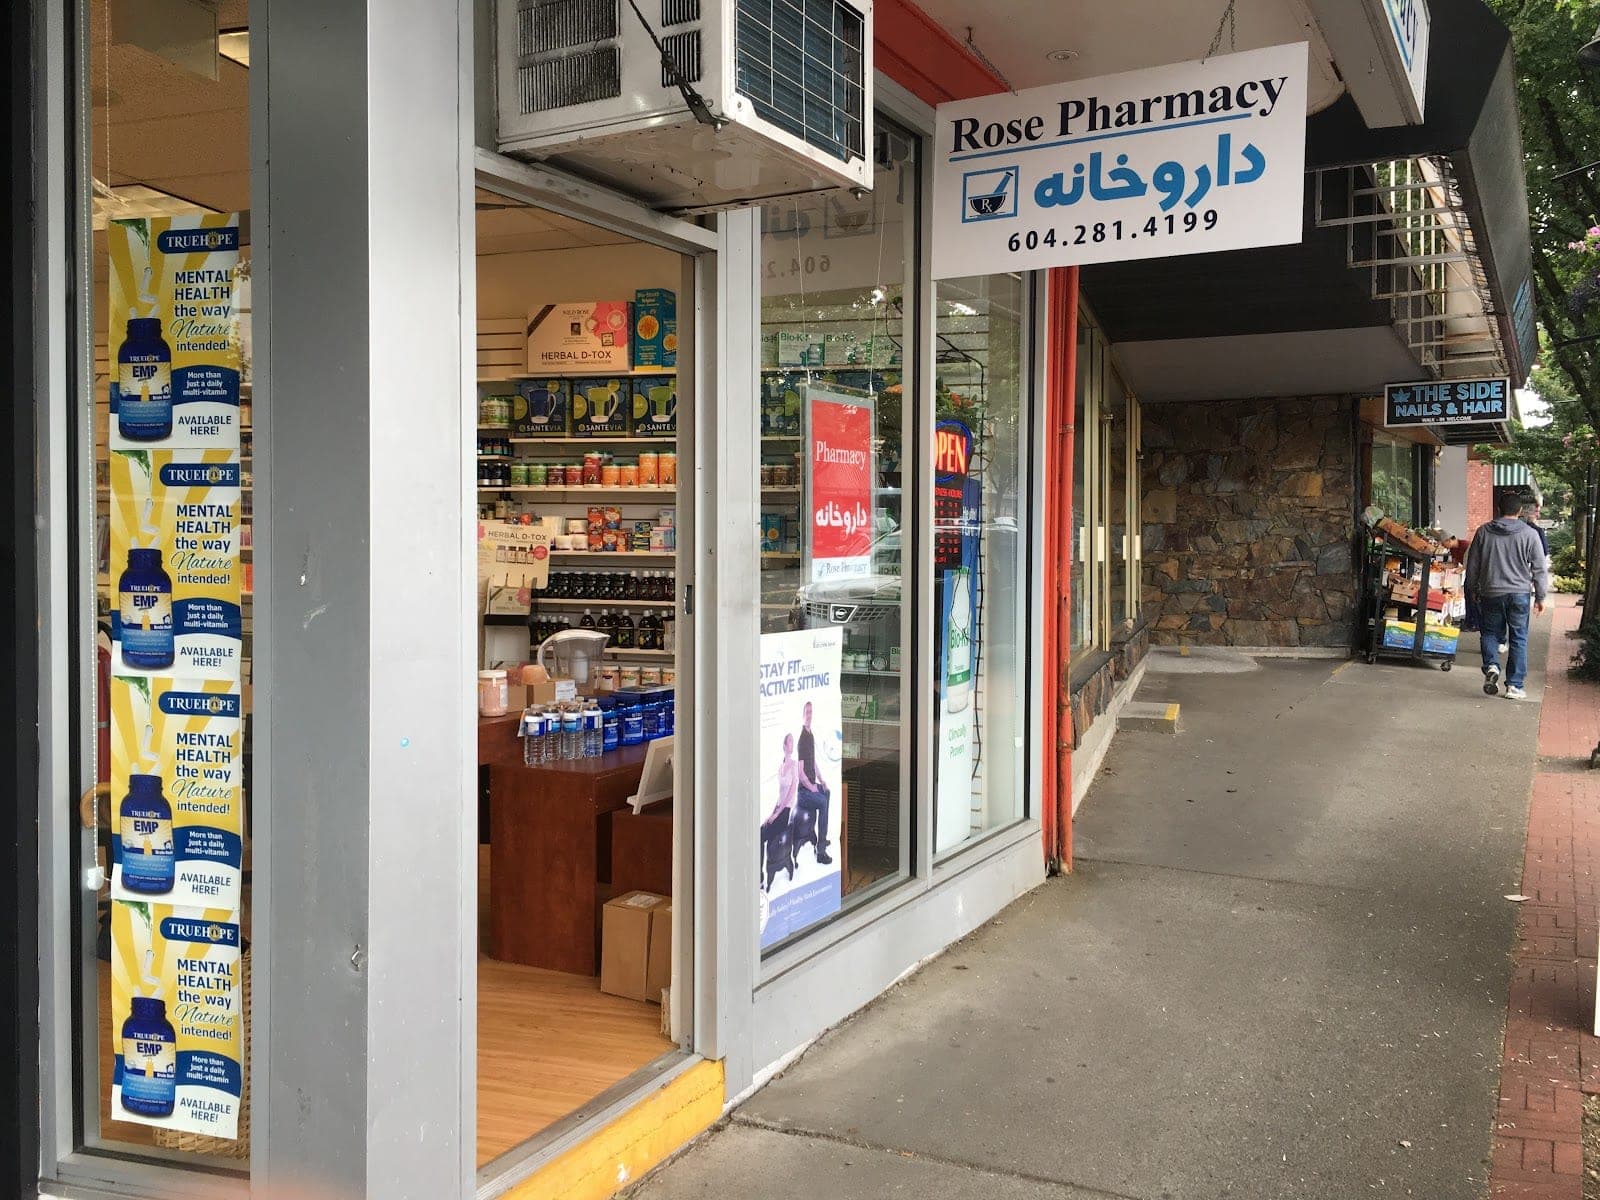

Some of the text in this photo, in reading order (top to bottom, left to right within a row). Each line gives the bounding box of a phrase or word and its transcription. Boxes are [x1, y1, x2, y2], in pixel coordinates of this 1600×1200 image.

[951, 76, 1289, 153] Rose Pharmacy
[1034, 133, 1266, 211] داروخانه
[1008, 209, 1218, 251] 604.281.4199
[166, 233, 232, 248] TRUEHOPE
[175, 270, 232, 284] MENTAL
[175, 287, 230, 300] HEALTH
[174, 304, 230, 319] the way
[170, 319, 232, 338] Nature
[177, 340, 230, 351] intended!
[542, 351, 611, 360] HERBAL D-TOX
[133, 365, 157, 377] EMP
[187, 380, 199, 388] just
[207, 380, 222, 388] daily
[1412, 382, 1503, 402] THE SIDE
[1396, 400, 1503, 417] NAILS & HAIR
[178, 415, 231, 425] AVAILABLE
[190, 426, 219, 435] HERE!
[816, 441, 866, 470] Pharmacy
[169, 469, 234, 482] TRUEHOPE
[177, 505, 232, 517] MENTAL
[816, 501, 867, 535] داروخانه
[176, 522, 230, 533] HEALTH
[522, 532, 546, 540] D-TOX
[175, 537, 230, 552] the way
[171, 552, 232, 570] Nature
[178, 573, 230, 584] intended!
[133, 595, 158, 607] EMP
[187, 612, 199, 620] just
[208, 612, 224, 621] daily
[180, 647, 233, 657] AVAILABLE
[193, 658, 221, 667] HERE!
[760, 662, 784, 678] STAY
[788, 659, 801, 674] FIT
[760, 672, 829, 697] ACTIVE SITTING
[168, 698, 234, 711] TRUEHOPE
[176, 733, 232, 747] MENTAL
[176, 749, 230, 763] HEALTH
[176, 765, 231, 783] the way
[171, 779, 232, 799] Nature
[177, 801, 229, 814] intended!
[134, 821, 159, 833] EMP
[189, 831, 206, 839] More
[189, 839, 200, 847] just
[208, 841, 224, 849] daily
[185, 847, 229, 857] multi-vitamin
[180, 873, 231, 886] AVAILABLE
[192, 885, 219, 895] HERE!
[169, 923, 234, 940] TRUEHOPE
[177, 959, 233, 976] MENTAL
[178, 975, 231, 991] HEALTH
[178, 991, 231, 1009] the way
[175, 1004, 234, 1026] Nature
[181, 1026, 231, 1040] intended!
[136, 1042, 162, 1054] EMP
[192, 1056, 208, 1064] More
[191, 1063, 203, 1072] just
[210, 1067, 225, 1076] daily
[186, 1071, 229, 1083] multi-vitamin
[180, 1098, 231, 1114] AVAILABLE
[191, 1110, 218, 1123] HERE!
